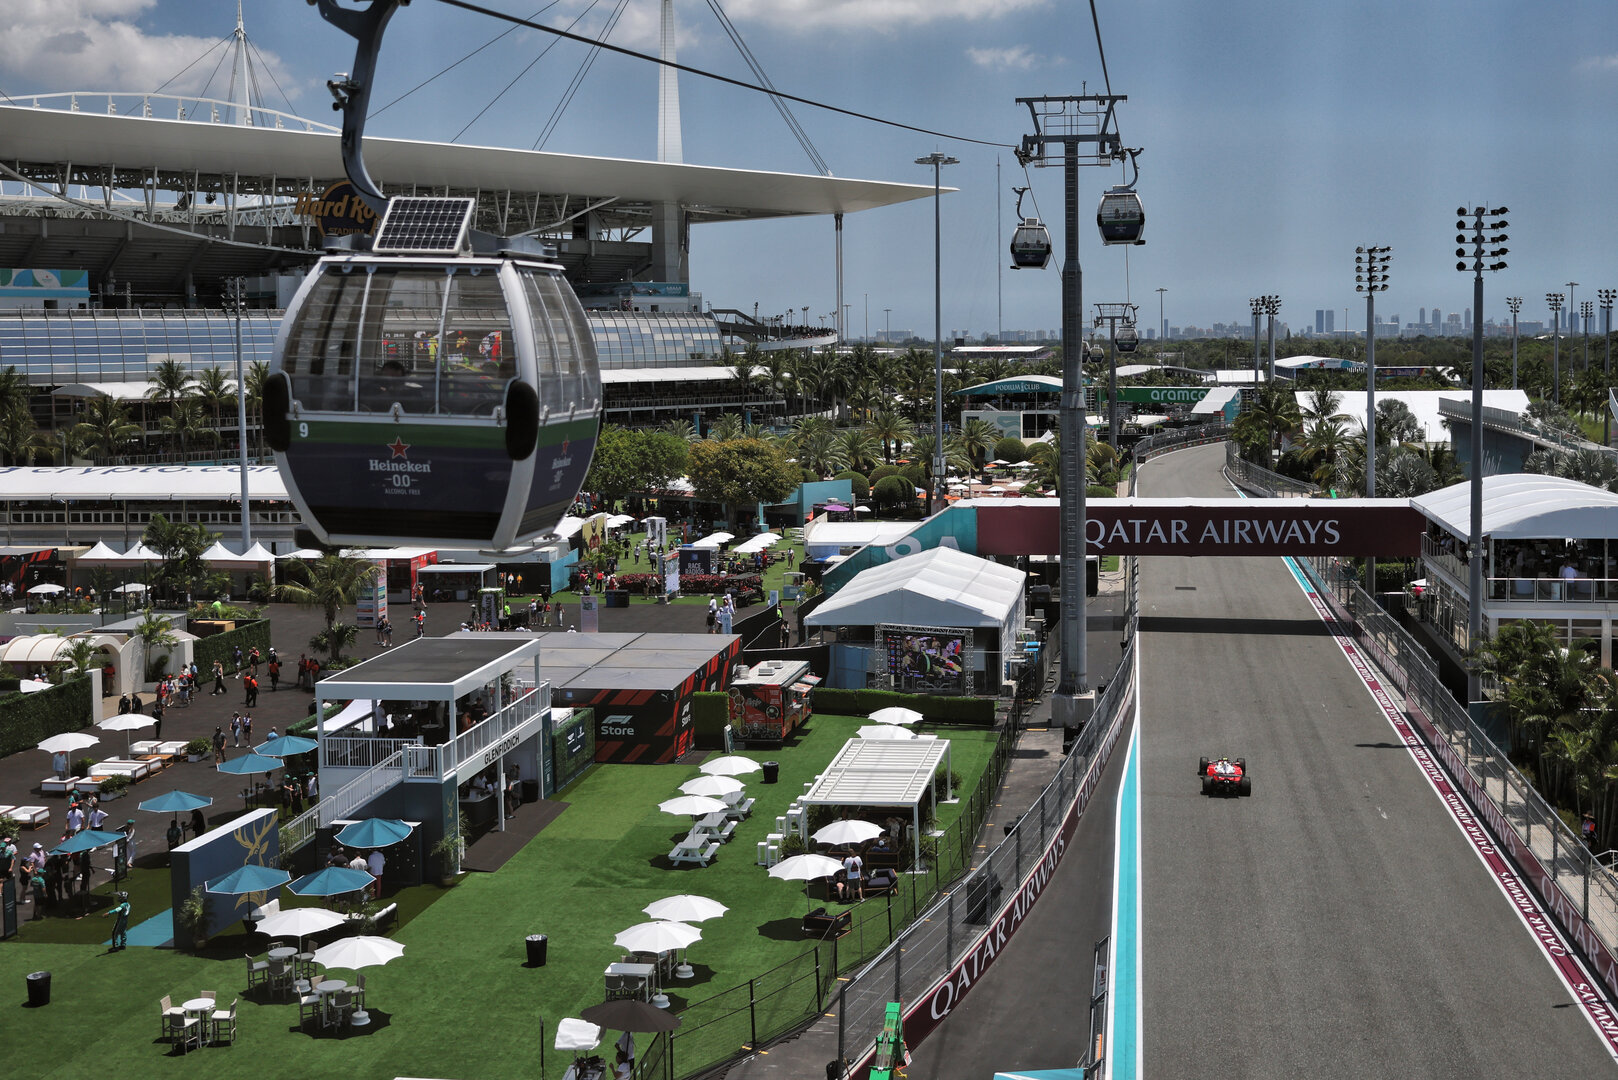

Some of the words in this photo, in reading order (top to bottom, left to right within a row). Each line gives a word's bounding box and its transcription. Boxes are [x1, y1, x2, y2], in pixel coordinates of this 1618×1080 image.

[294, 192, 349, 217] Hard
[350, 195, 382, 224] Ro
[1150, 389, 1206, 401] aramco
[299, 422, 309, 438] 9
[368, 459, 431, 472] Heineken
[1085, 519, 1190, 549] QATAR
[1199, 519, 1340, 544] AIRWAYS
[601, 725, 635, 735] Store
[485, 732, 519, 764] GLENFIDDICH
[1435, 733, 1466, 791] QATAR
[1467, 780, 1516, 857] AIRWAYS
[1498, 871, 1535, 914] AIRWAYS
[931, 917, 1006, 1020] QATAR
[1010, 830, 1065, 932] AIRWAYS
[1529, 916, 1566, 957] QATAR
[1541, 875, 1601, 972] QATAR
